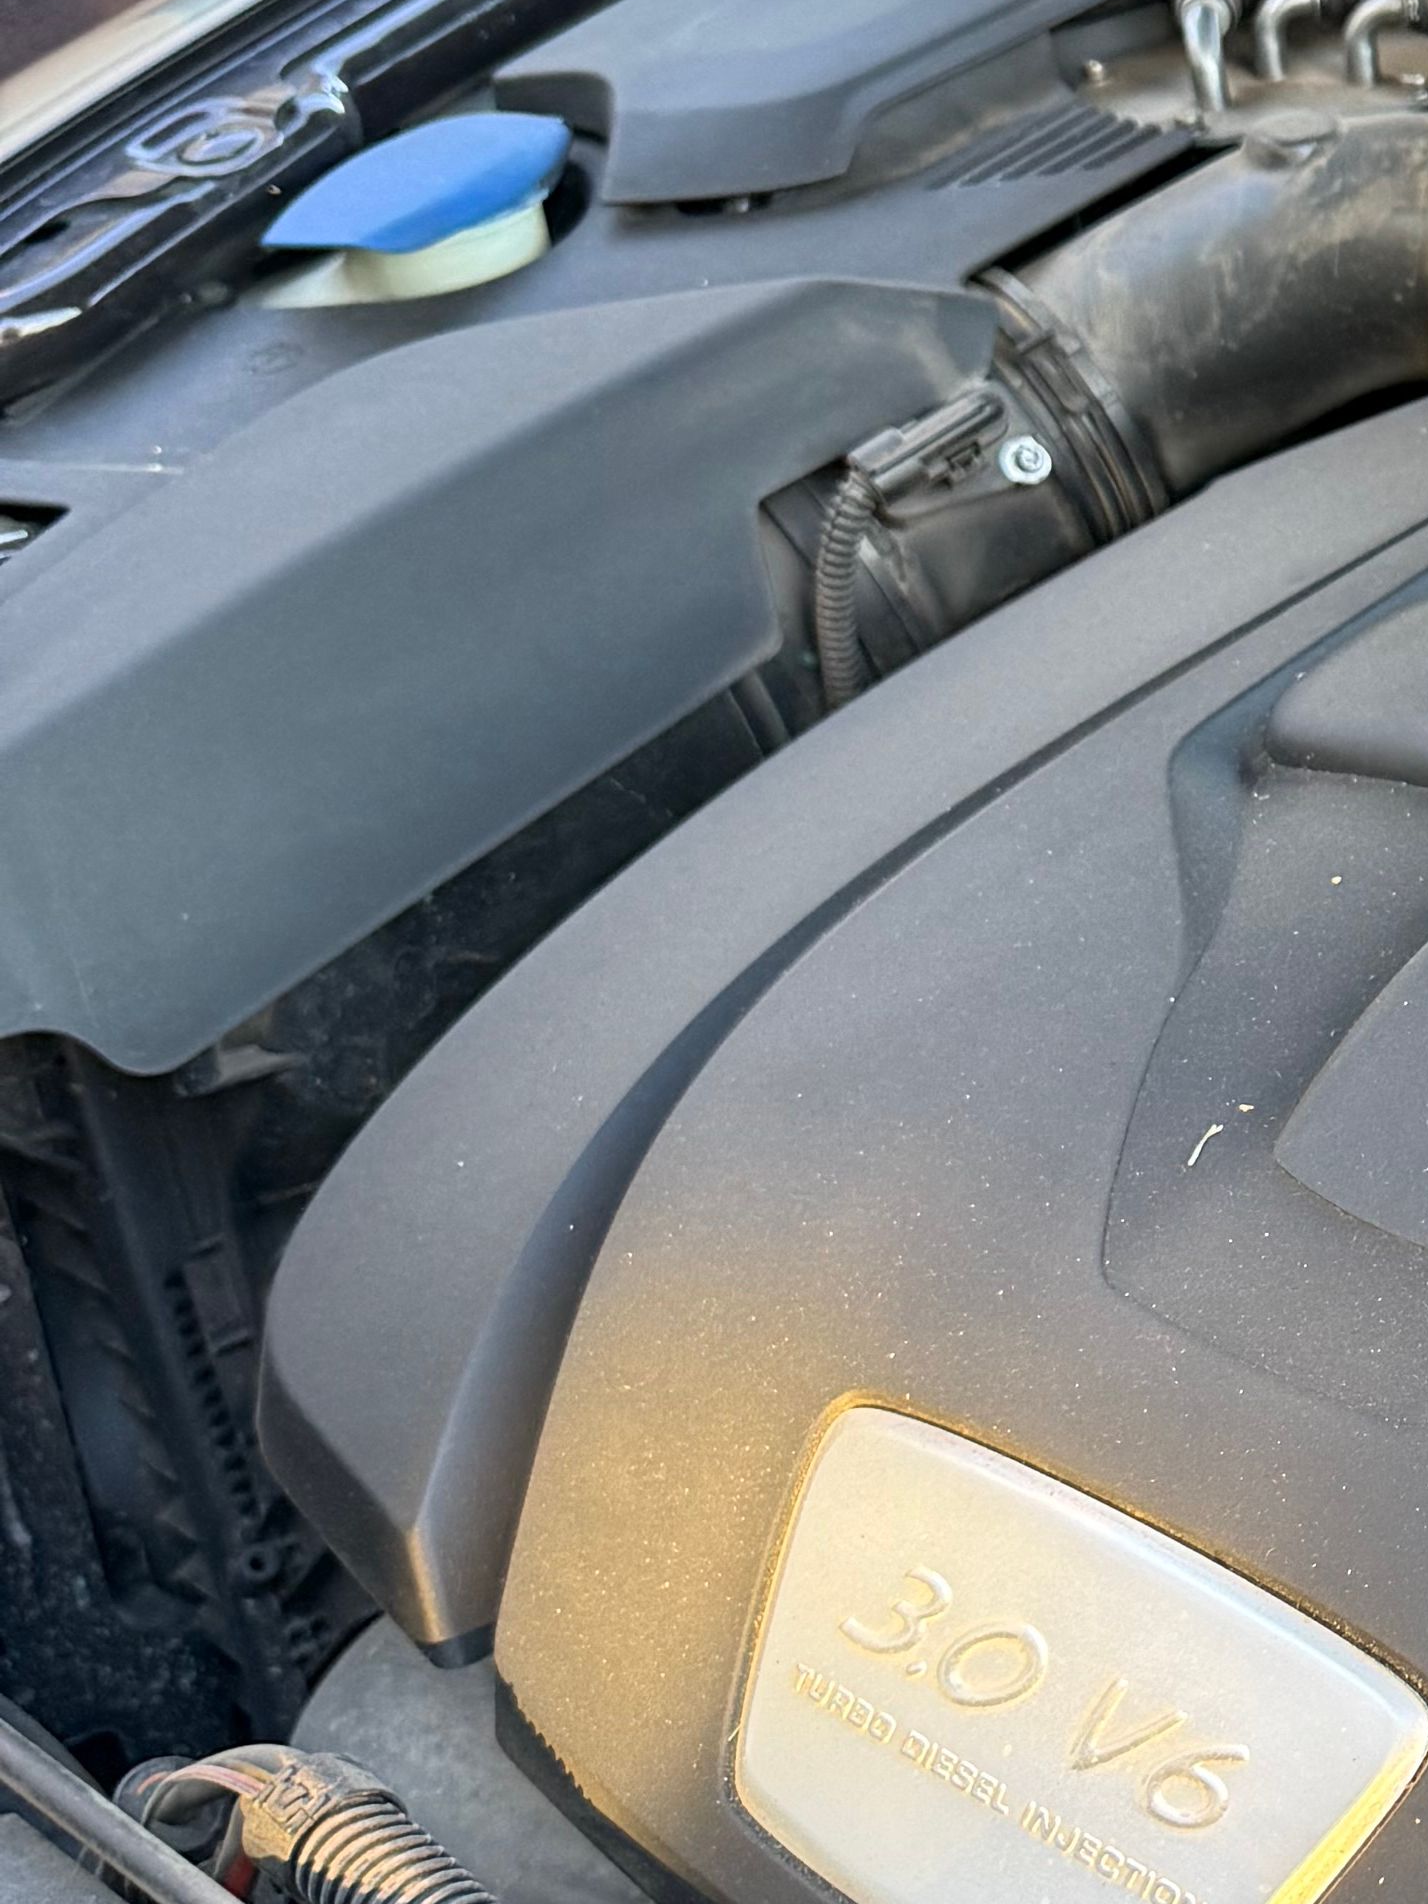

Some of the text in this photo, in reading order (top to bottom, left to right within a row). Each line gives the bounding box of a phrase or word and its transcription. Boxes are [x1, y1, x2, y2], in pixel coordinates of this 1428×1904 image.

[793, 1661, 897, 1746] TURBO
[902, 1728, 1011, 1818] DIESEL
[1070, 1678, 1250, 1831] V6
